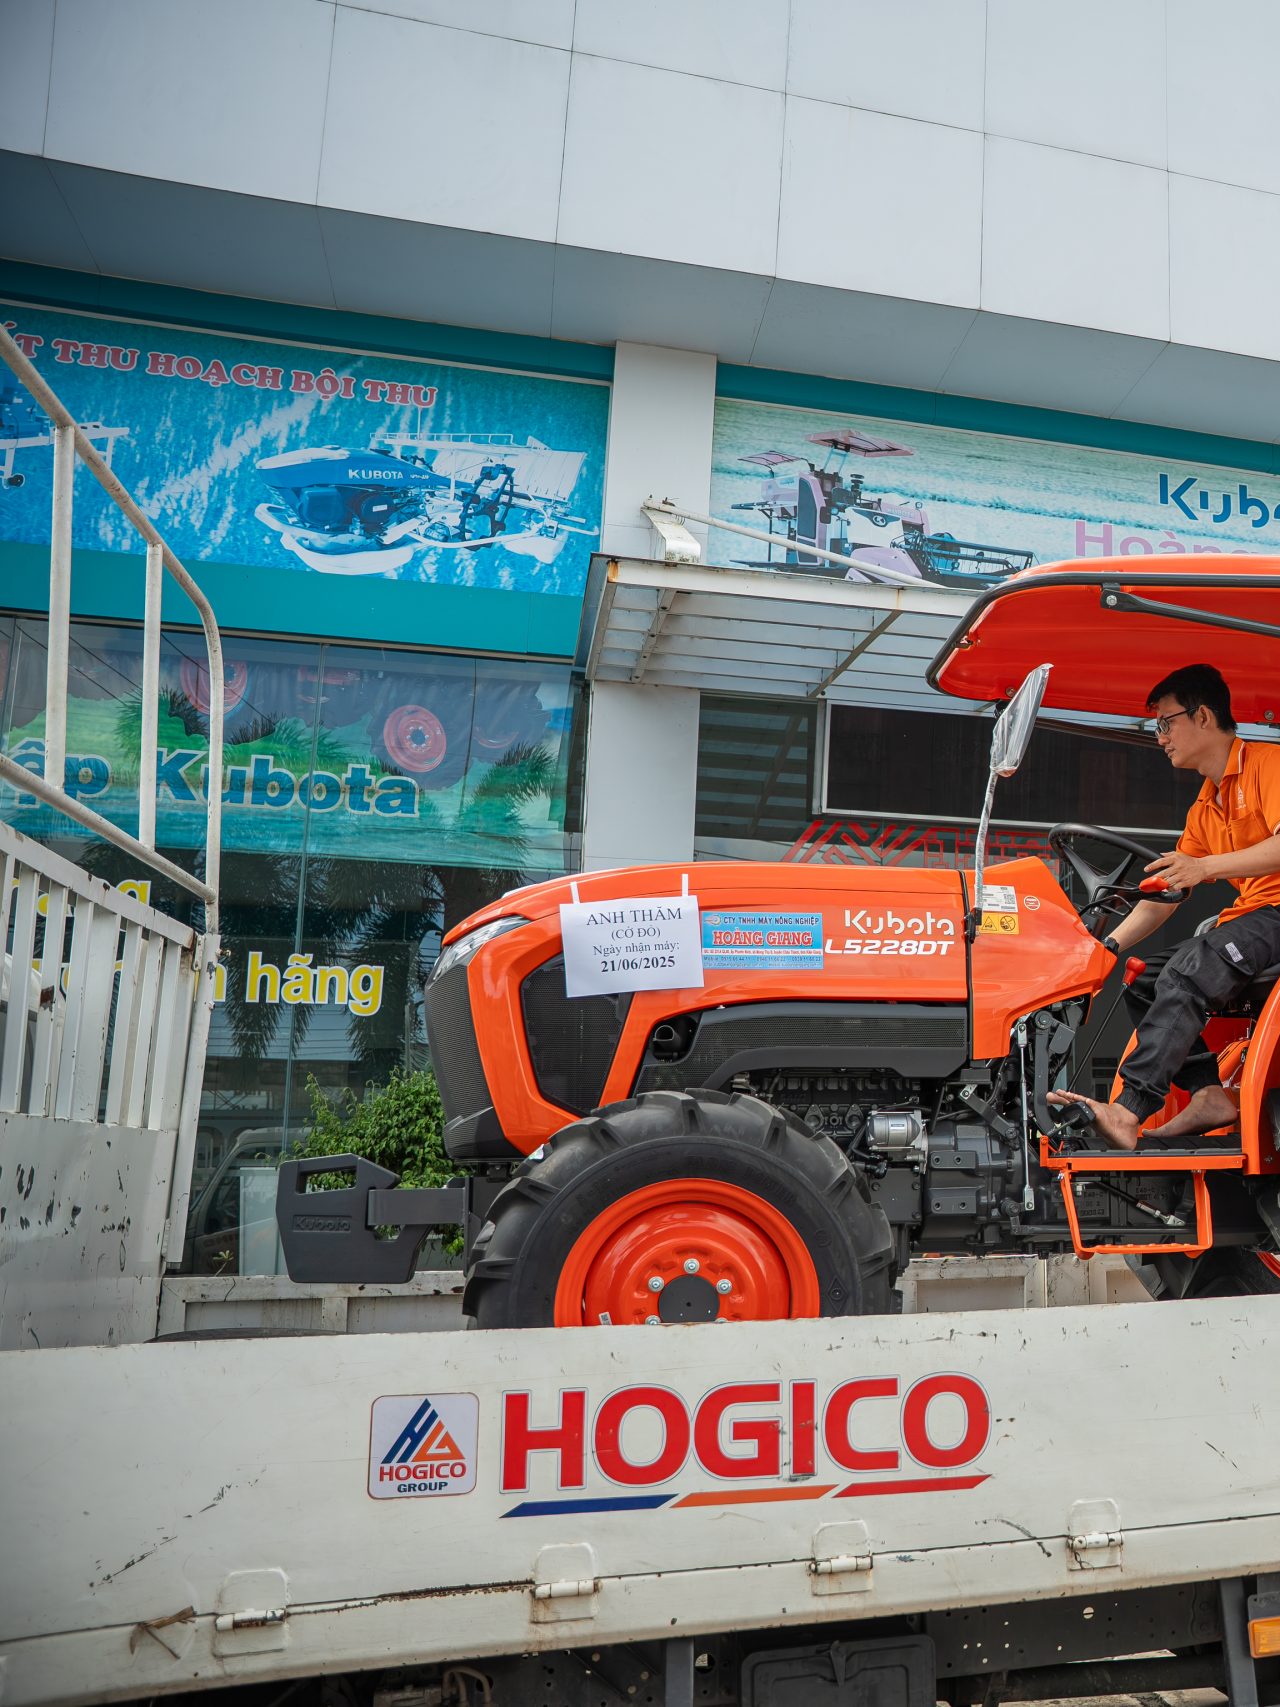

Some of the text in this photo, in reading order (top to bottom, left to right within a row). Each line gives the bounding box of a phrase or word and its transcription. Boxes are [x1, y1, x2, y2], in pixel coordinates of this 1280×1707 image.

[52, 338, 139, 371] THU
[145, 352, 284, 390] HOẠCH
[289, 367, 356, 400] BỘI
[362, 379, 438, 407] THU
[348, 469, 404, 480] KUBOTA
[586, 906, 682, 926] ANH THĂM
[775, 916, 793, 925] NÔNG
[795, 917, 819, 926] NGHIỆP
[844, 909, 955, 936] Kubota
[713, 927, 813, 946] HOÀNG GIANG
[593, 940, 680, 957] Ngày nhận máy:
[824, 938, 955, 956] L5228DT
[601, 956, 676, 973] 21/06/2025
[245, 951, 384, 1016] hãng
[295, 1216, 351, 1232] Kubota
[501, 1371, 992, 1494] HOGICO
[379, 1462, 467, 1482] HOGICO
[397, 1481, 448, 1493] GROUP
